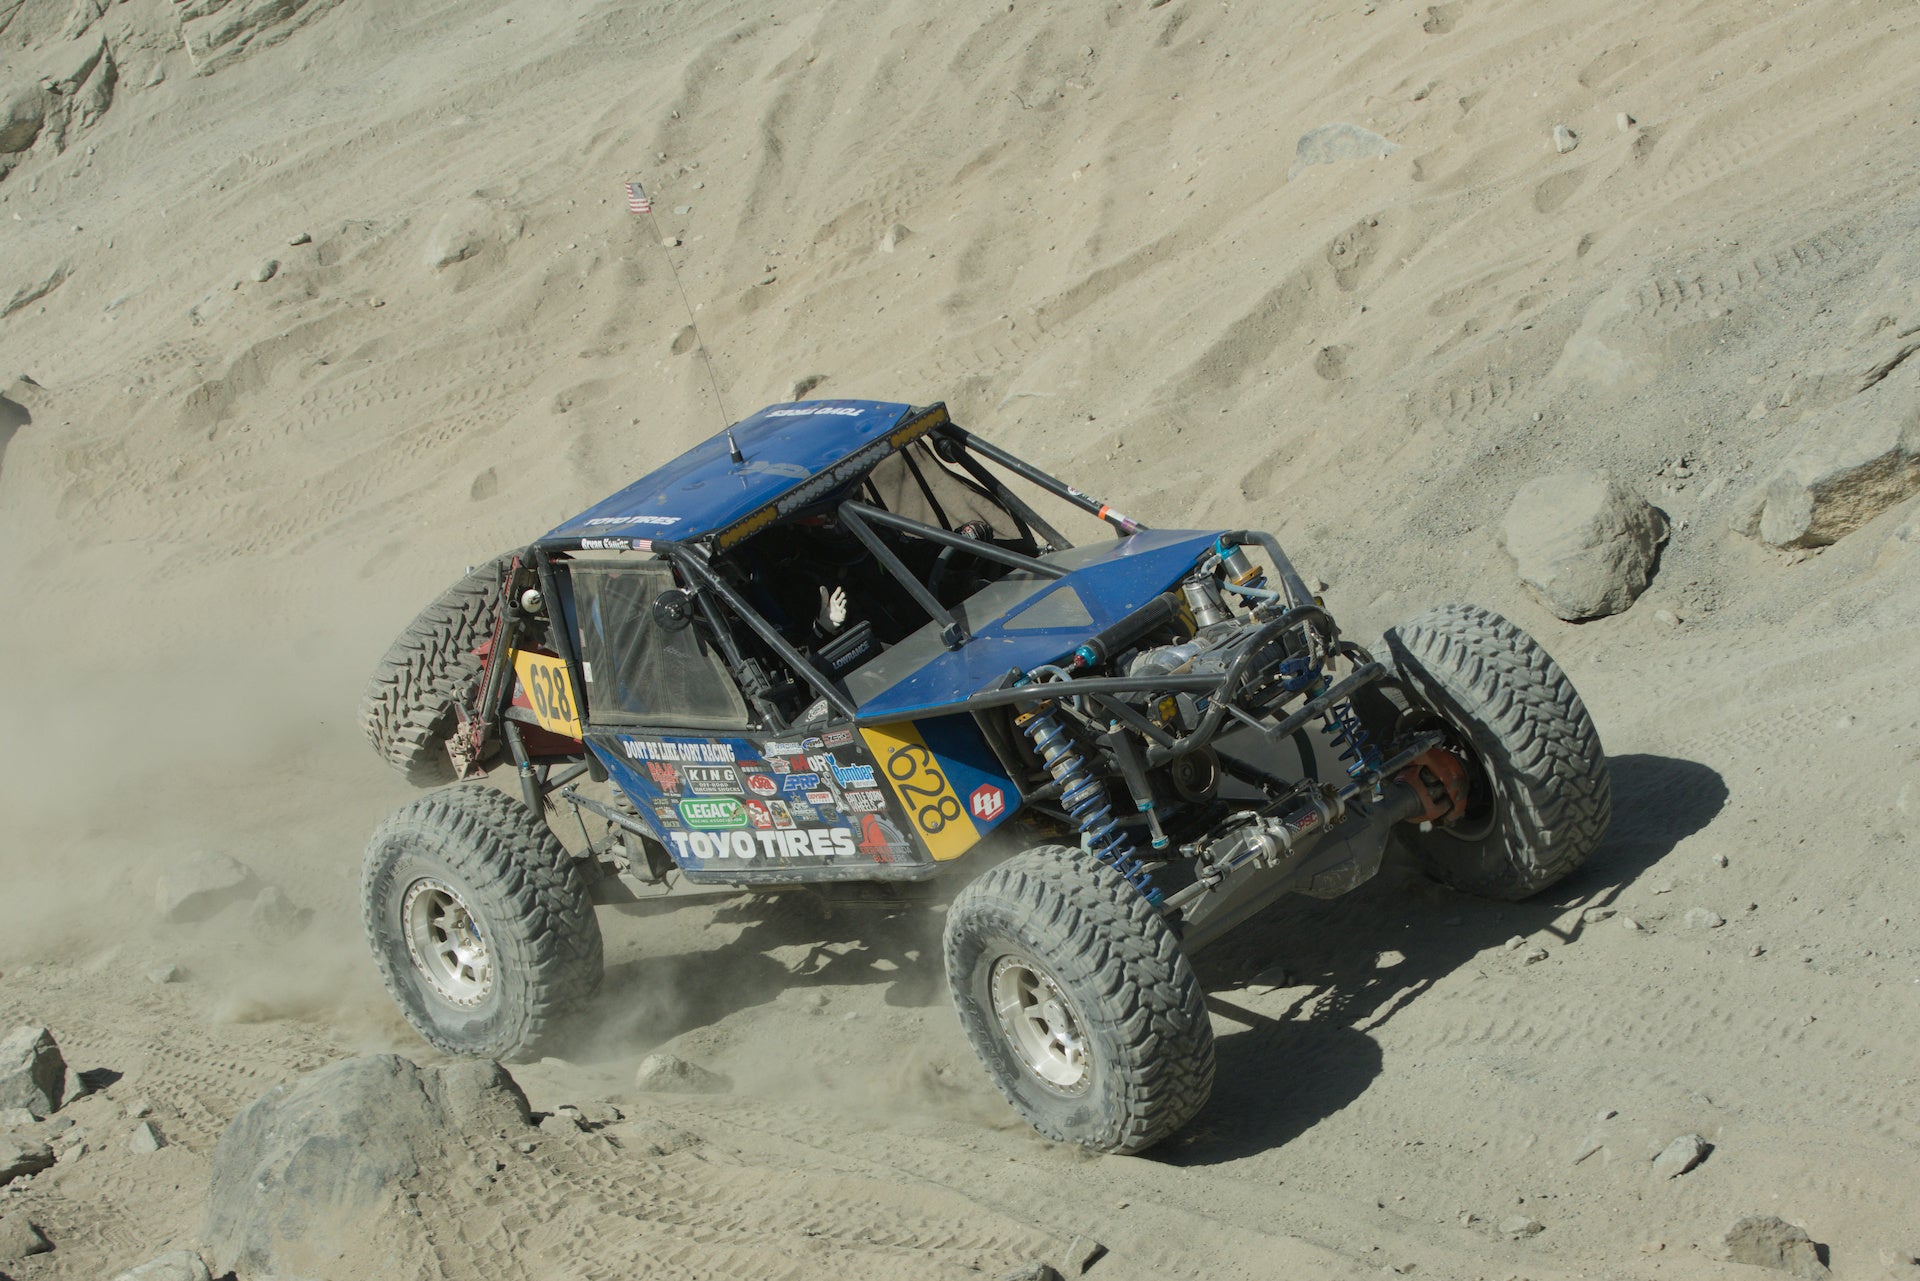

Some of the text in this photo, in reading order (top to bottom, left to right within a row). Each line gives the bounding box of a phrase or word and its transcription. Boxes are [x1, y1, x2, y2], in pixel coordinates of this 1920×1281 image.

[832, 640, 870, 670] LOWRANCE
[530, 664, 571, 722] 628
[646, 742, 661, 761] BE
[657, 743, 681, 761] LIKE
[677, 743, 703, 762] CORY
[700, 744, 736, 763] RACING
[689, 769, 735, 781] KING
[887, 744, 961, 835] 628
[684, 803, 737, 819] LEGACY
[670, 831, 757, 859] TOYO
[755, 828, 857, 858] TIRES
